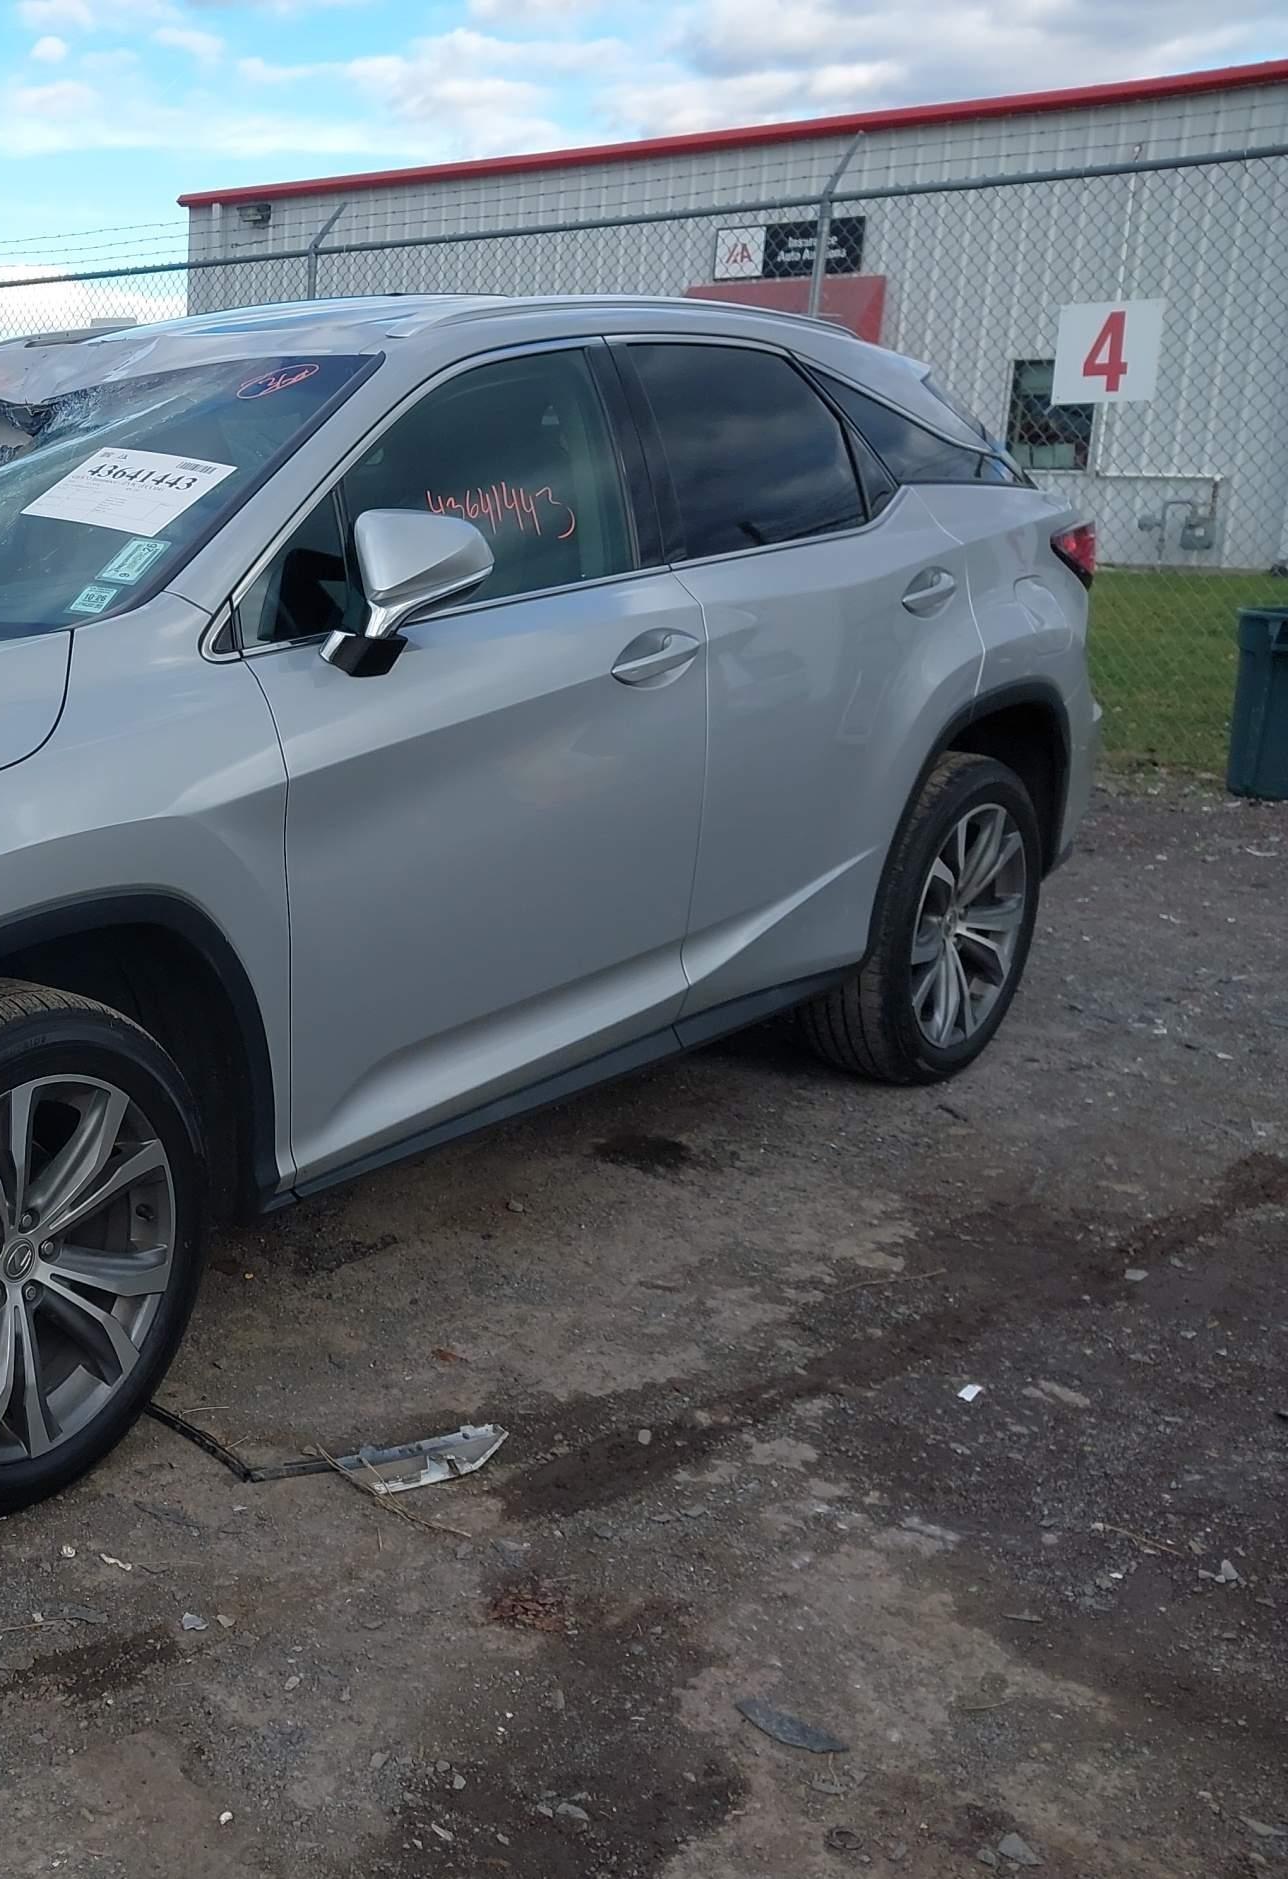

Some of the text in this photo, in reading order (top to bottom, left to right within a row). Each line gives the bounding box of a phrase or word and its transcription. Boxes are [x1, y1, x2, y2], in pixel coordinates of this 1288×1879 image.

[777, 250, 801, 262] Auto
[1082, 310, 1128, 392] 4
[87, 463, 199, 491] 43641443
[426, 481, 576, 539] 43641443
